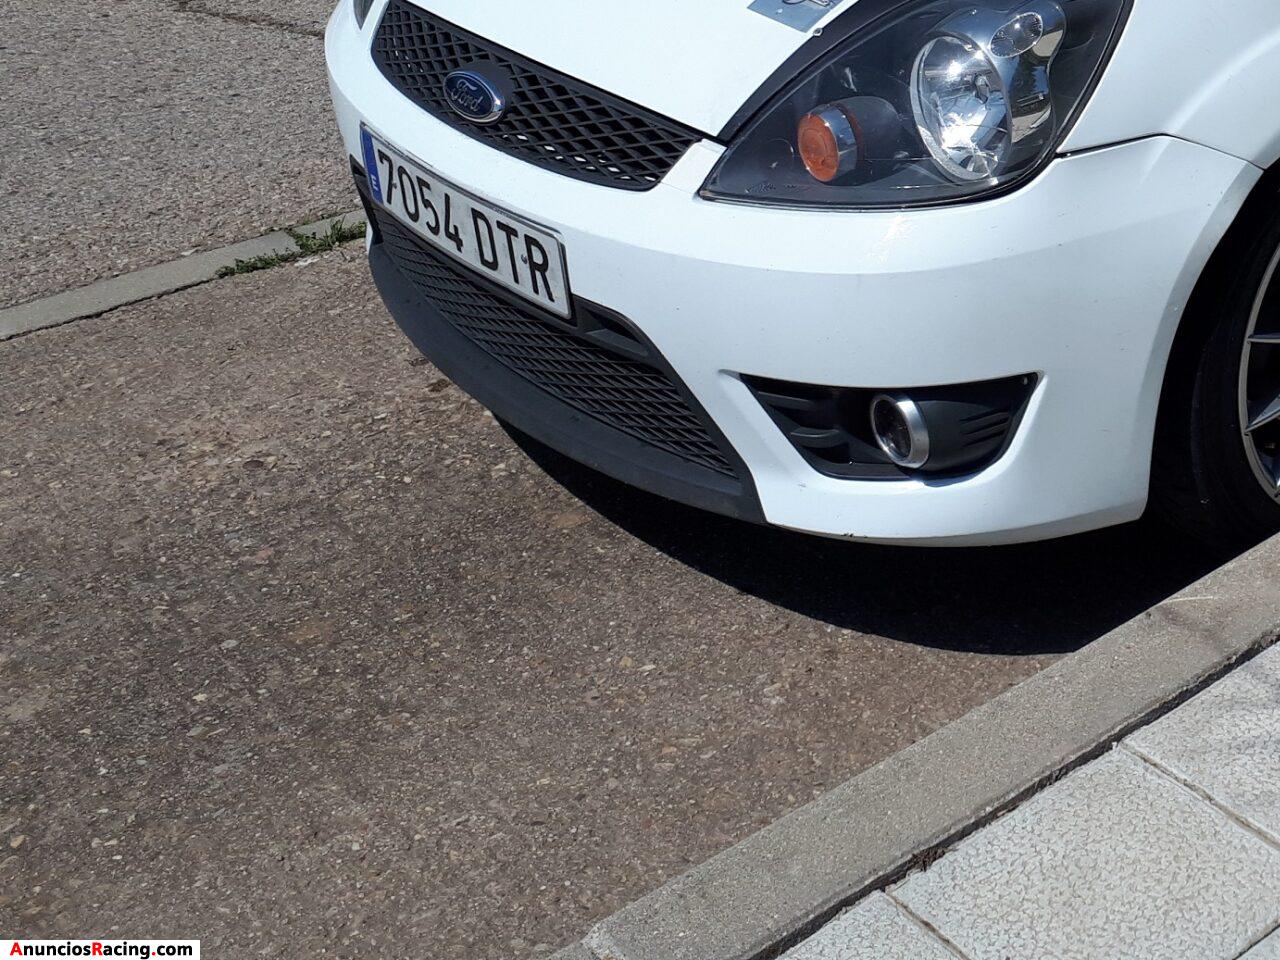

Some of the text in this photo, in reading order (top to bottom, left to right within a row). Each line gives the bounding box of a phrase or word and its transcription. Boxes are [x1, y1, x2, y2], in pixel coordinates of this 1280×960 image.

[449, 79, 484, 112] Ford
[377, 148, 555, 303] 7054 DTR
